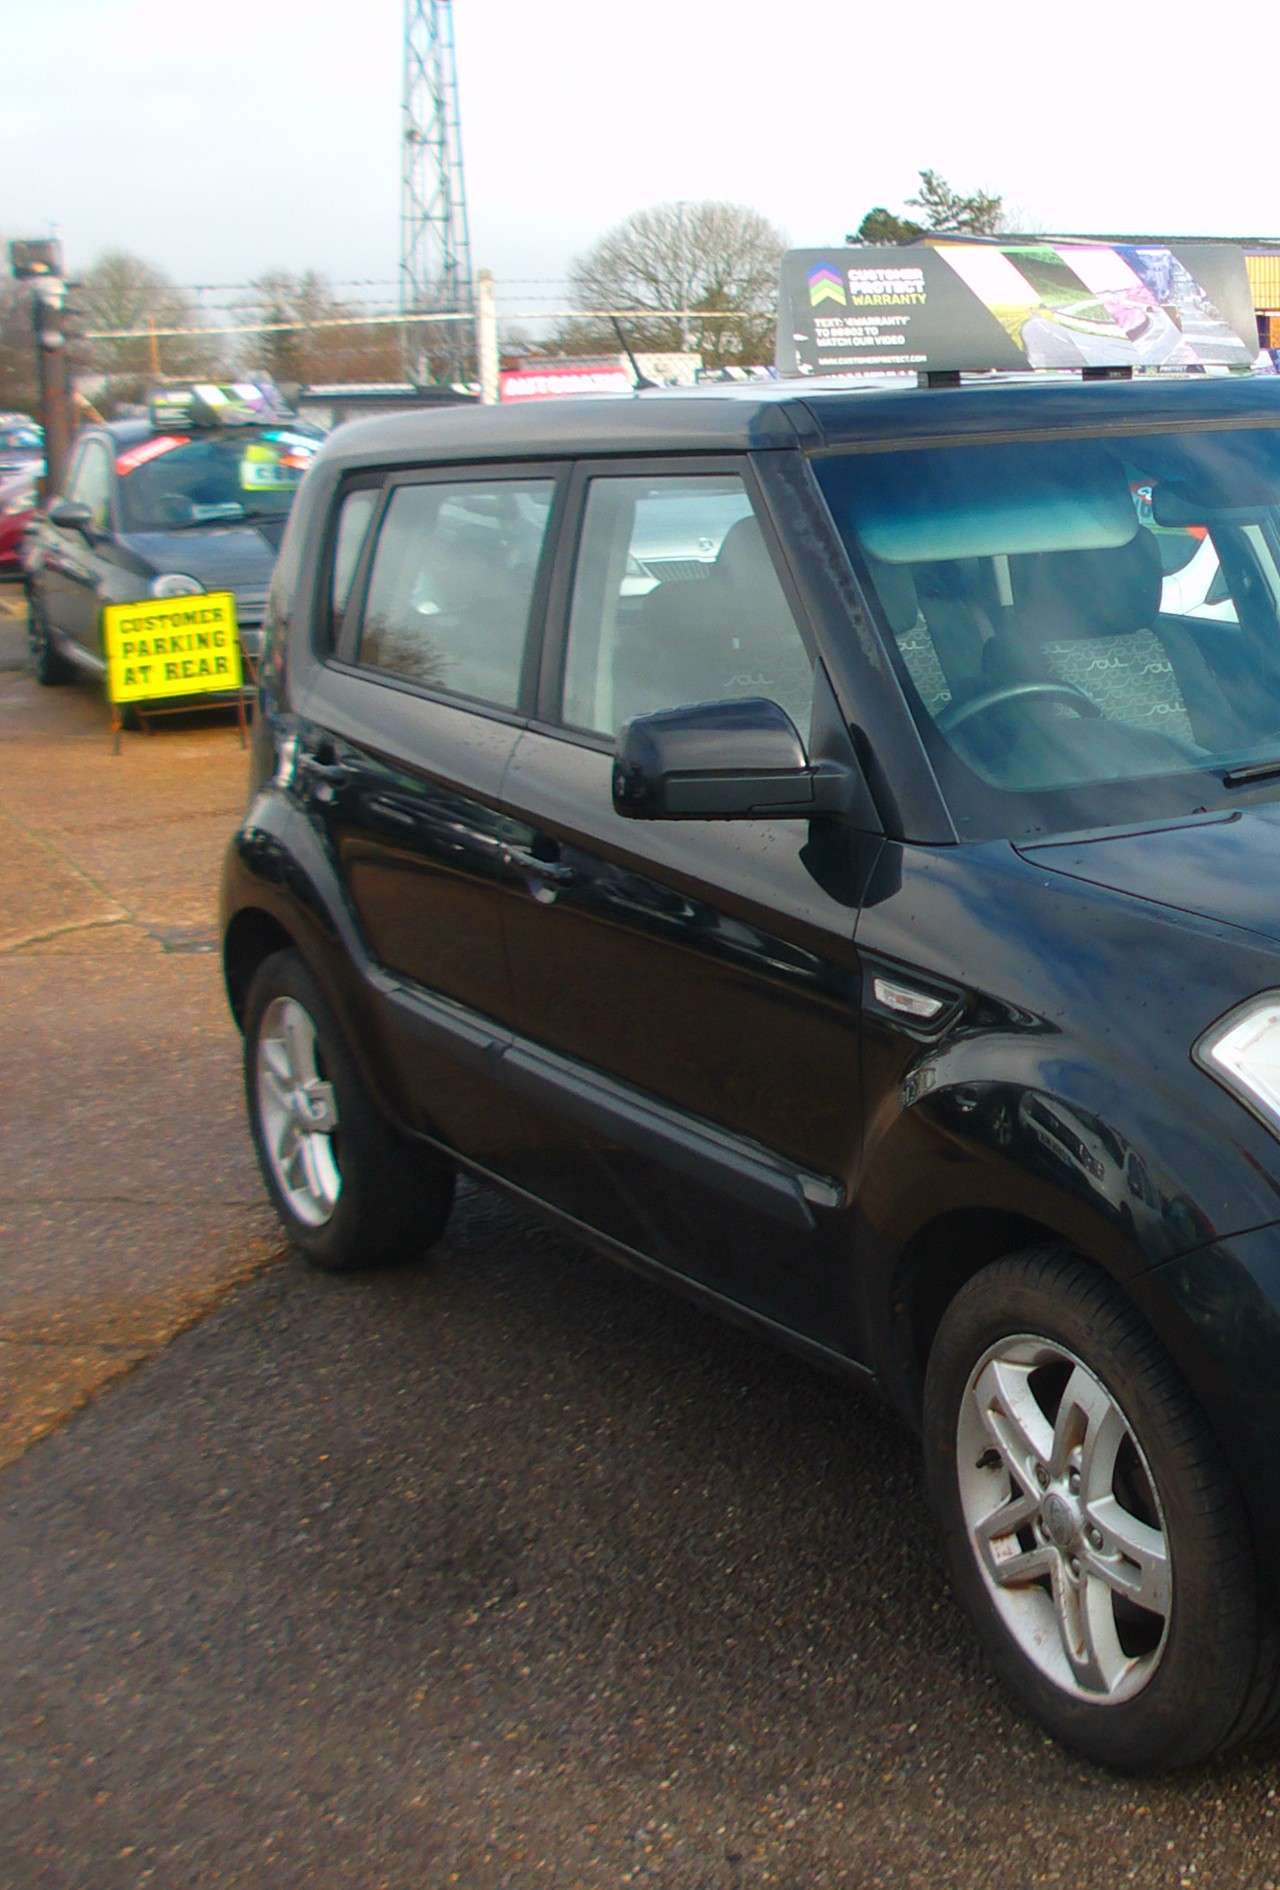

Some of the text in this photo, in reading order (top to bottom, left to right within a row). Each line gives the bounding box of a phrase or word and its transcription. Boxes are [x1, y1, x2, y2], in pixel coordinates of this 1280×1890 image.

[848, 268, 924, 281] CUSTOMER
[849, 280, 925, 294] PROTECT
[852, 293, 927, 306] WARRANTY
[815, 327, 830, 337] TO
[864, 326, 879, 336] TO
[852, 336, 875, 346] OUR
[875, 335, 906, 345] VIDEO
[119, 608, 223, 634] CUSTOMER
[122, 630, 225, 658] PARKING
[124, 665, 152, 686] AT
[164, 656, 228, 681] REAR
